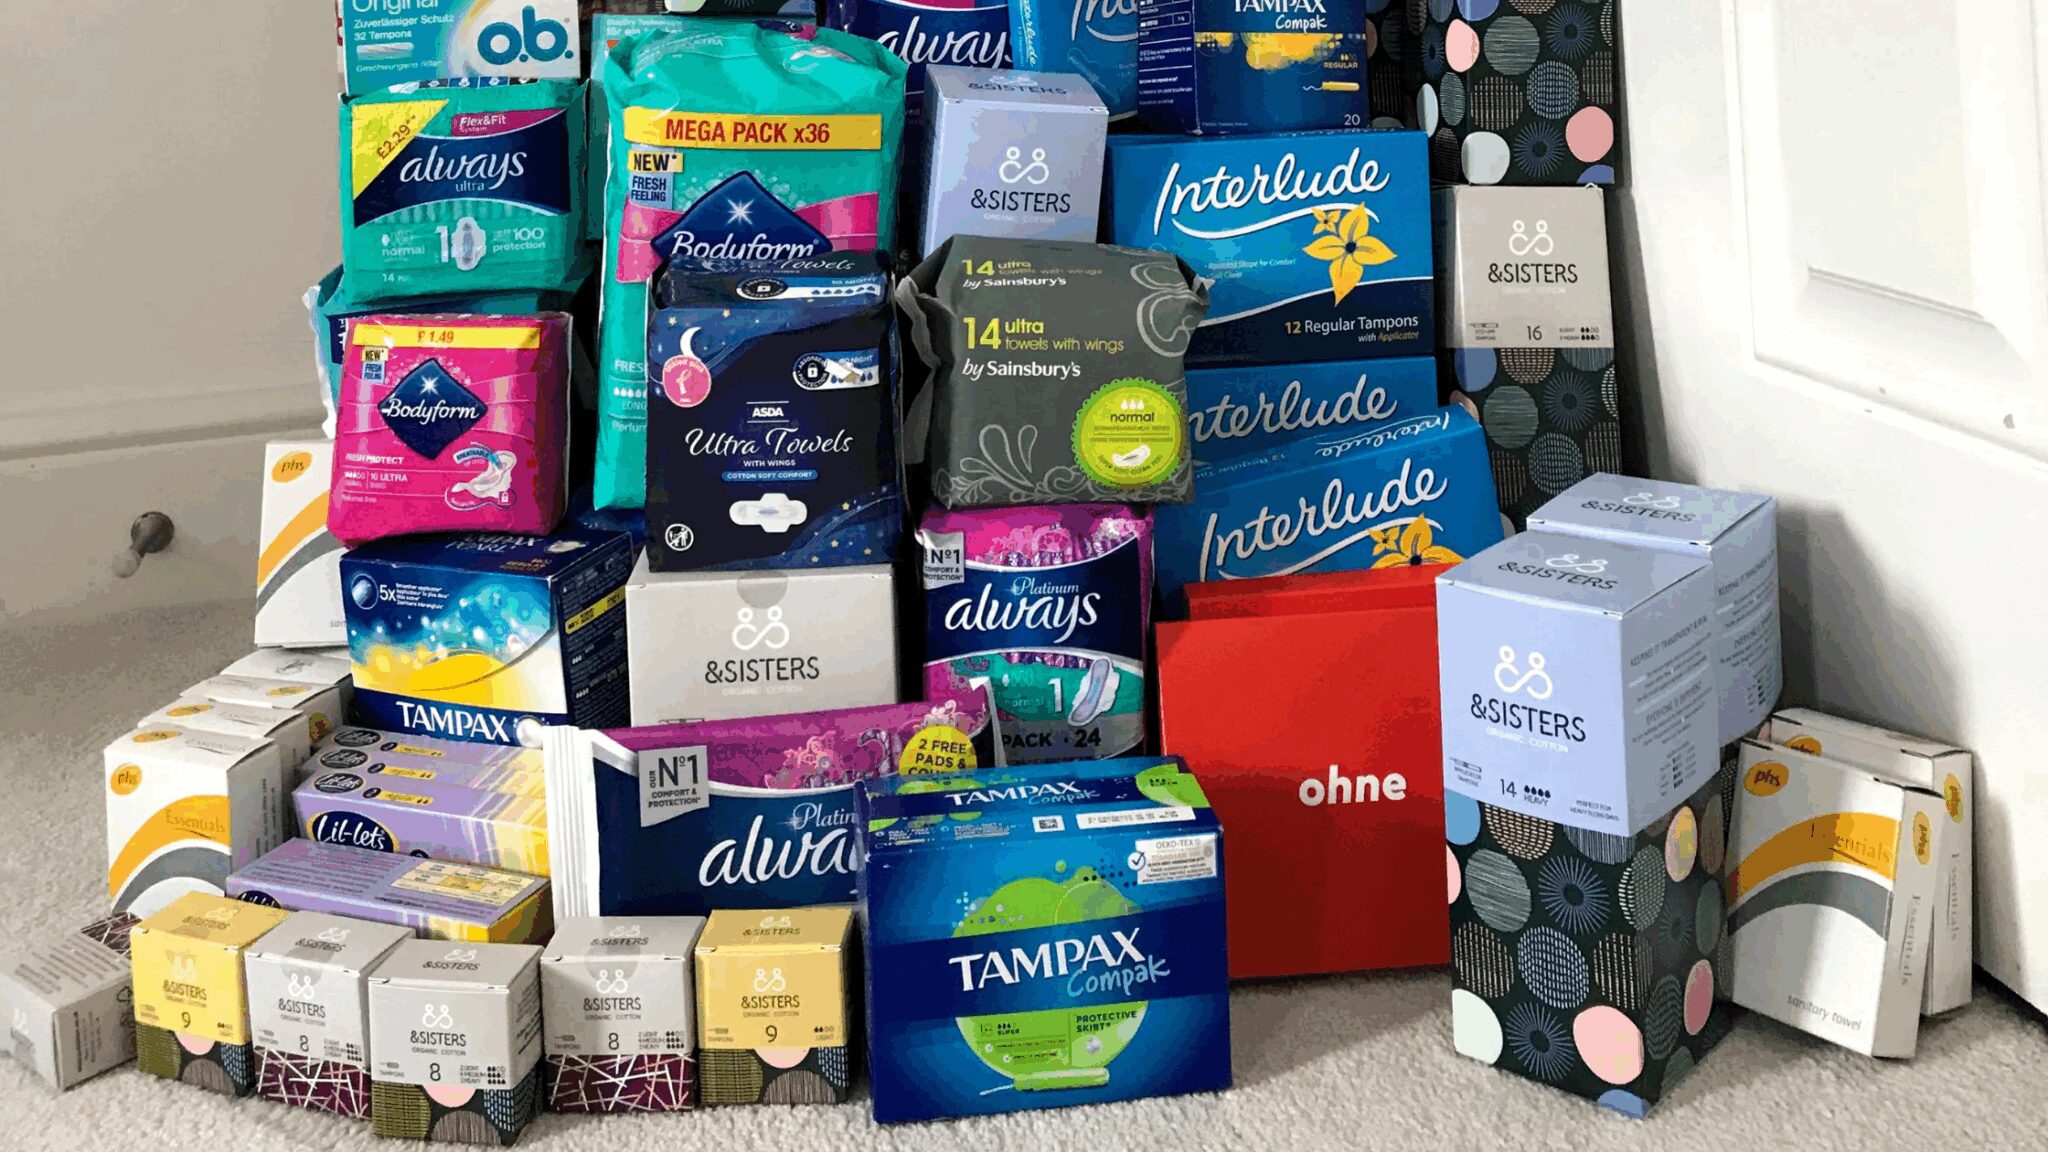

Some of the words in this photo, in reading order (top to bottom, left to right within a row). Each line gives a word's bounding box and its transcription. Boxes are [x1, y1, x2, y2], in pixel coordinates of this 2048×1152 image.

[1275, 14, 1328, 33] Compak
[354, 32, 367, 41] 32
[477, 5, 574, 66] o.b.
[876, 16, 1013, 69] alway
[460, 114, 506, 127] Flex&Fit
[1344, 114, 1360, 126] 20
[665, 118, 725, 142] MEGA
[732, 122, 787, 143] PACK
[794, 123, 831, 144] x36
[399, 145, 528, 190] always
[455, 180, 485, 192] ultra
[632, 175, 667, 191] FRESH
[1154, 147, 1391, 236] Interlude
[630, 189, 667, 202] FEELING
[970, 188, 1071, 213] &SISTERS
[492, 241, 545, 253] protection
[961, 259, 995, 275] 14
[1487, 263, 1578, 283] &SISTERS
[382, 274, 395, 282] 14
[963, 279, 981, 288] by
[984, 277, 1067, 287] Sainsbury's
[963, 316, 1001, 350] 14
[1005, 318, 1044, 334] ultra
[1284, 322, 1301, 334] 12
[1304, 317, 1356, 337] Regular
[1357, 315, 1419, 332] Tampons
[1526, 325, 1543, 341] 16
[1005, 338, 1048, 350] towels
[1053, 338, 1080, 350] with
[1085, 339, 1124, 354] wings
[1358, 332, 1377, 343] with
[1378, 331, 1419, 343] Applicator
[614, 359, 648, 374] FRES
[962, 358, 984, 380] by
[986, 360, 1081, 380] Sainsbury's
[386, 399, 480, 426] Bodyform
[752, 407, 784, 418] ASDA
[1110, 412, 1155, 422] normal
[684, 428, 760, 456] Ultra
[764, 427, 854, 456] Towels
[281, 458, 305, 472] phs
[743, 459, 765, 467] WITH
[766, 458, 796, 467] WINGS
[380, 473, 408, 482] ULTRA
[726, 472, 756, 480] COTTON
[757, 471, 776, 480] SOFT
[777, 471, 813, 479] COMFORT
[1200, 458, 1448, 583] Interlude
[1581, 500, 1696, 523] &SISTERS
[1498, 561, 1618, 591] &SISTERS
[379, 584, 397, 602] 5x
[1013, 576, 1080, 596] Platinum
[944, 582, 1101, 644] always
[704, 656, 820, 684] &SISTERS
[1048, 678, 1063, 713] 1
[395, 701, 511, 742] TAMPAX
[1470, 693, 1587, 743] &SISTERS
[918, 738, 927, 750] 2
[931, 740, 967, 755] FREE
[1003, 733, 1052, 748] PACK
[1074, 729, 1102, 747] 24
[915, 752, 954, 768] PADS
[957, 757, 966, 769] &
[1298, 764, 1407, 806] ohne
[1754, 768, 1781, 788] phs
[652, 788, 691, 799] COMFORT
[945, 780, 1081, 807] TAMPAX
[1028, 789, 1101, 806] Compak
[1500, 778, 1518, 798] 14
[1523, 793, 1549, 807] HEAVY
[165, 808, 226, 834] Essentials
[793, 802, 856, 830] Platin
[699, 814, 858, 887] alwa
[422, 960, 481, 972] &SISTERS
[949, 927, 1147, 991] TAMPAX
[1066, 955, 1171, 998] Compak
[163, 979, 208, 1001] &SISTERS
[278, 998, 326, 1019] &SISTERS
[583, 997, 642, 1012] &SISTERS
[740, 995, 801, 1009] &SISTERS
[181, 1011, 191, 1028] 9
[1076, 1010, 1138, 1023] PROTECTIVE
[1787, 993, 1829, 1023] sanitary
[1831, 1009, 1862, 1031] towel
[410, 1030, 467, 1047] &SISTERS
[608, 1032, 620, 1051] 8
[765, 1024, 778, 1043] 9
[300, 1034, 310, 1053] 8
[429, 1062, 442, 1082] 8
